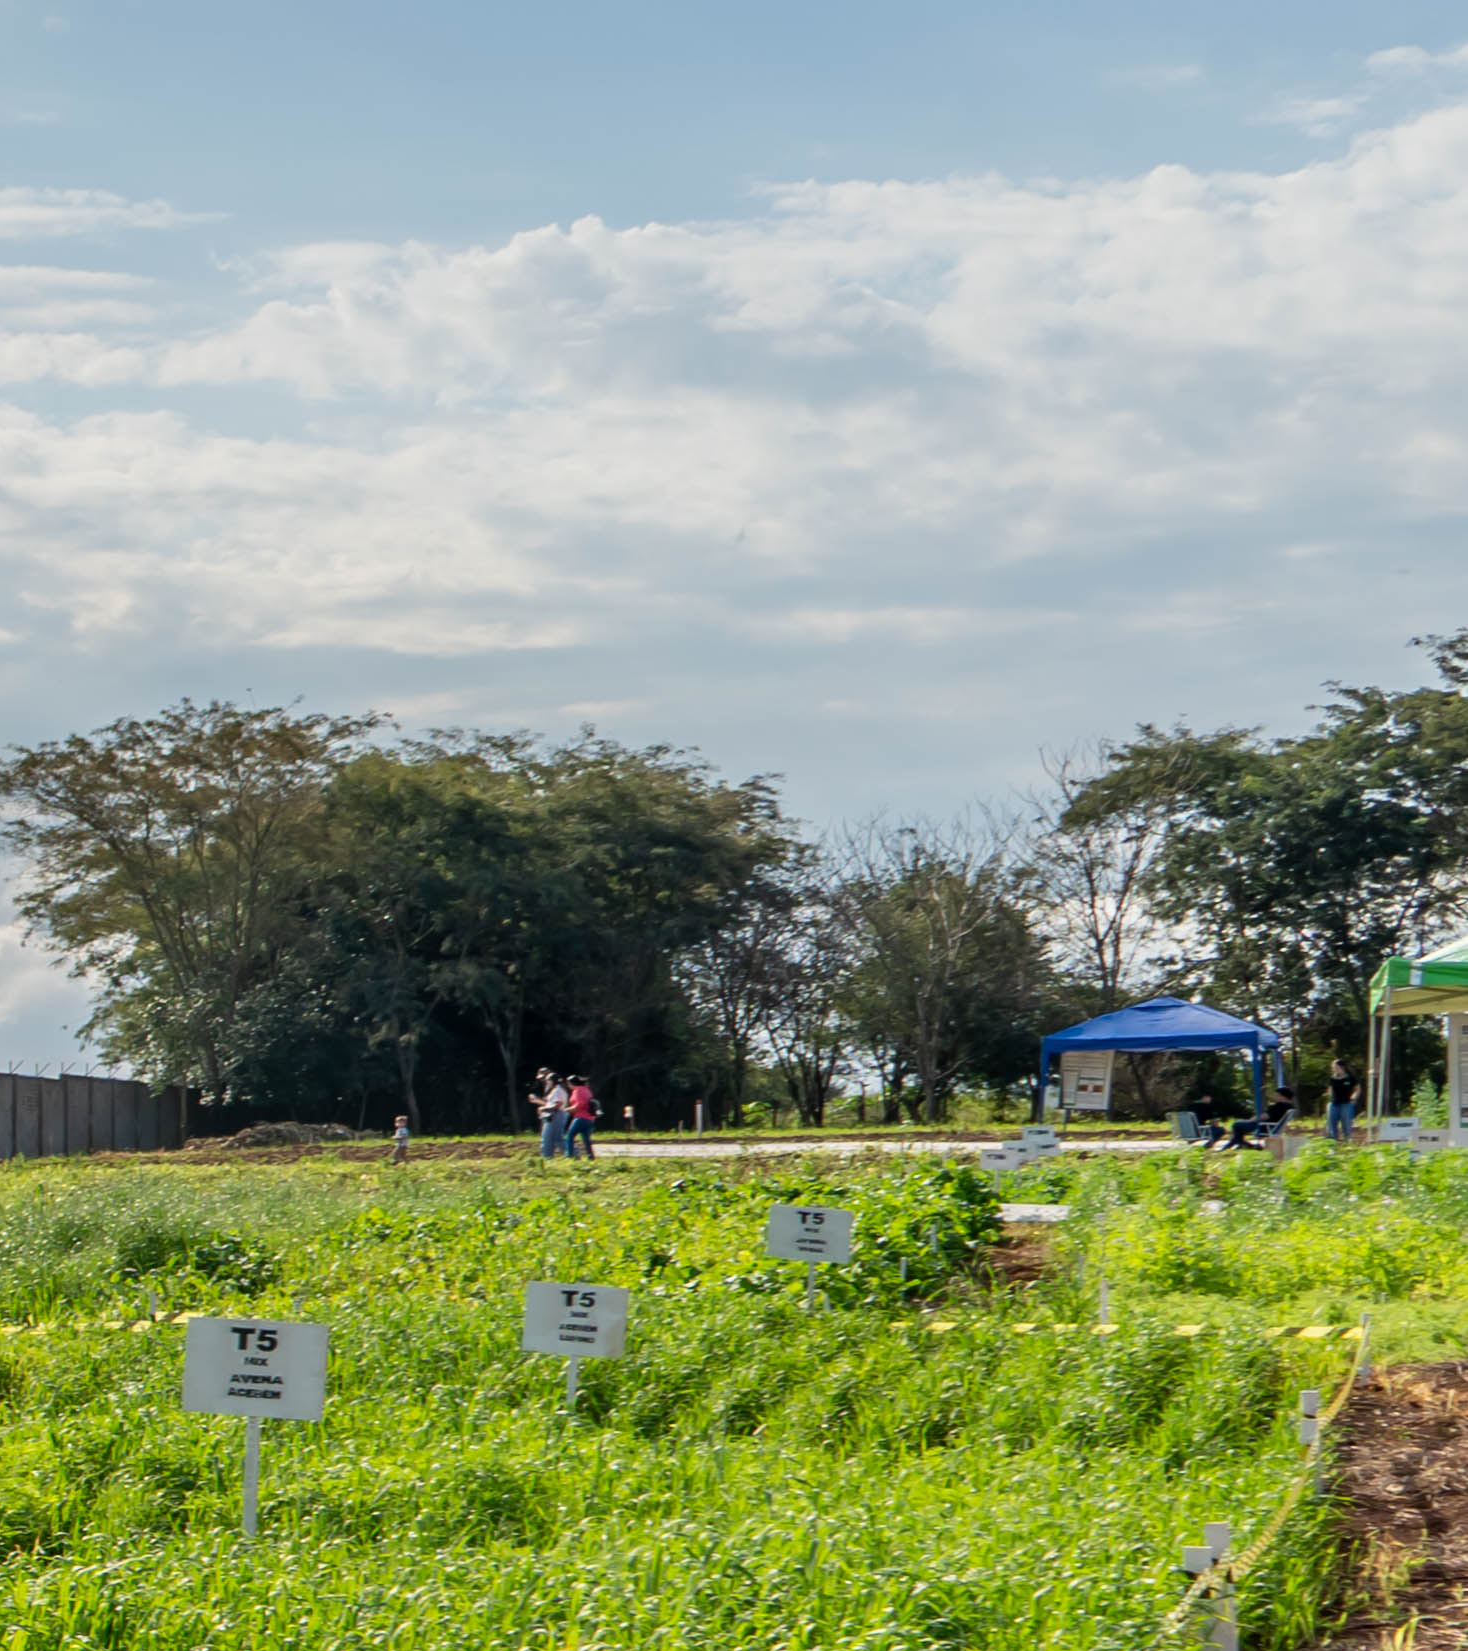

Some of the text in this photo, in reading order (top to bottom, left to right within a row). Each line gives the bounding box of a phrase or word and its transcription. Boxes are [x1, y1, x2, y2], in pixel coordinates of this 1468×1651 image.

[797, 1211, 825, 1225] T5
[561, 1290, 596, 1307] T5
[231, 1327, 278, 1352] T5
[230, 1374, 283, 1384] AVENA
